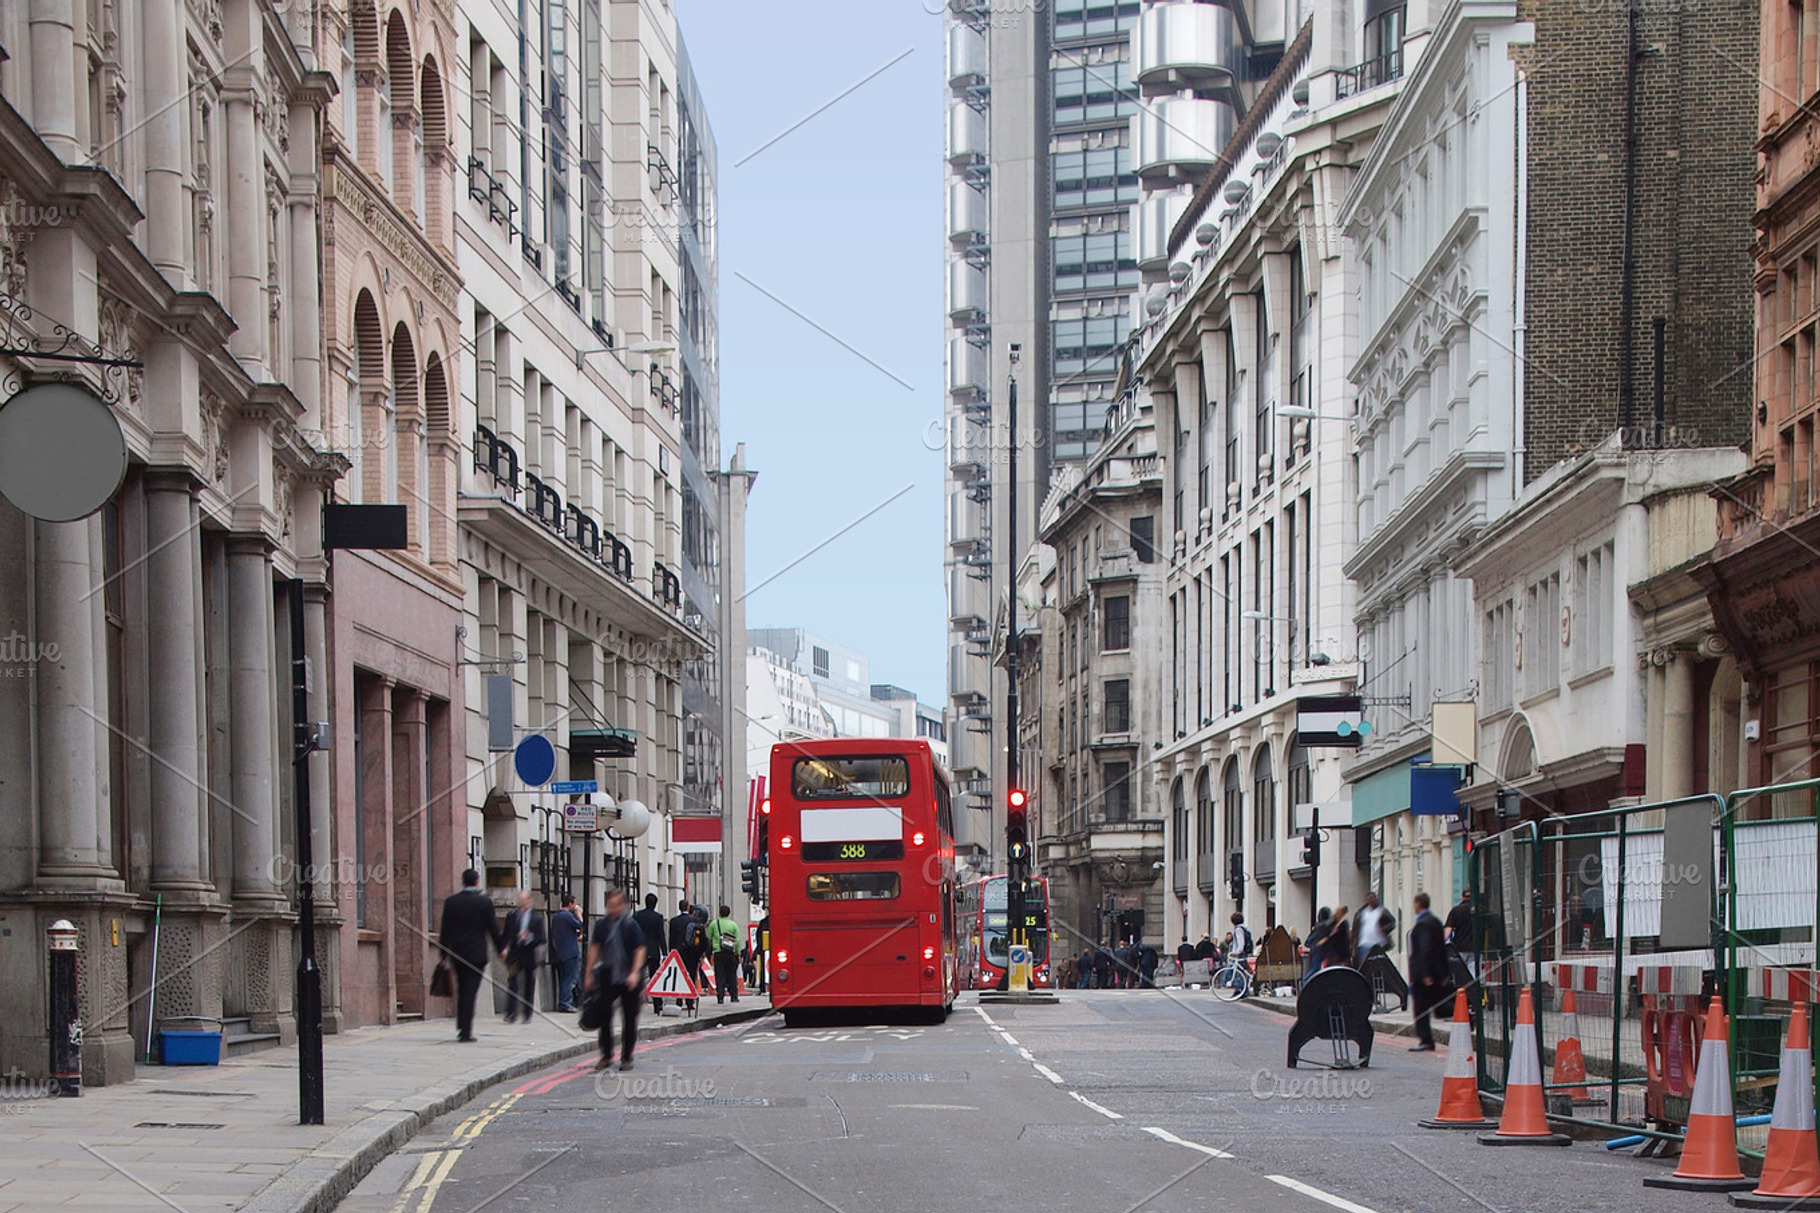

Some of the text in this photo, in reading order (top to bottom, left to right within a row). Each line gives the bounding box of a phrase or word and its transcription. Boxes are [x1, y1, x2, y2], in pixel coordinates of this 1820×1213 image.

[840, 844, 866, 859] 388
[1025, 916, 1036, 926] 25
[742, 1032, 925, 1044] ONLY
